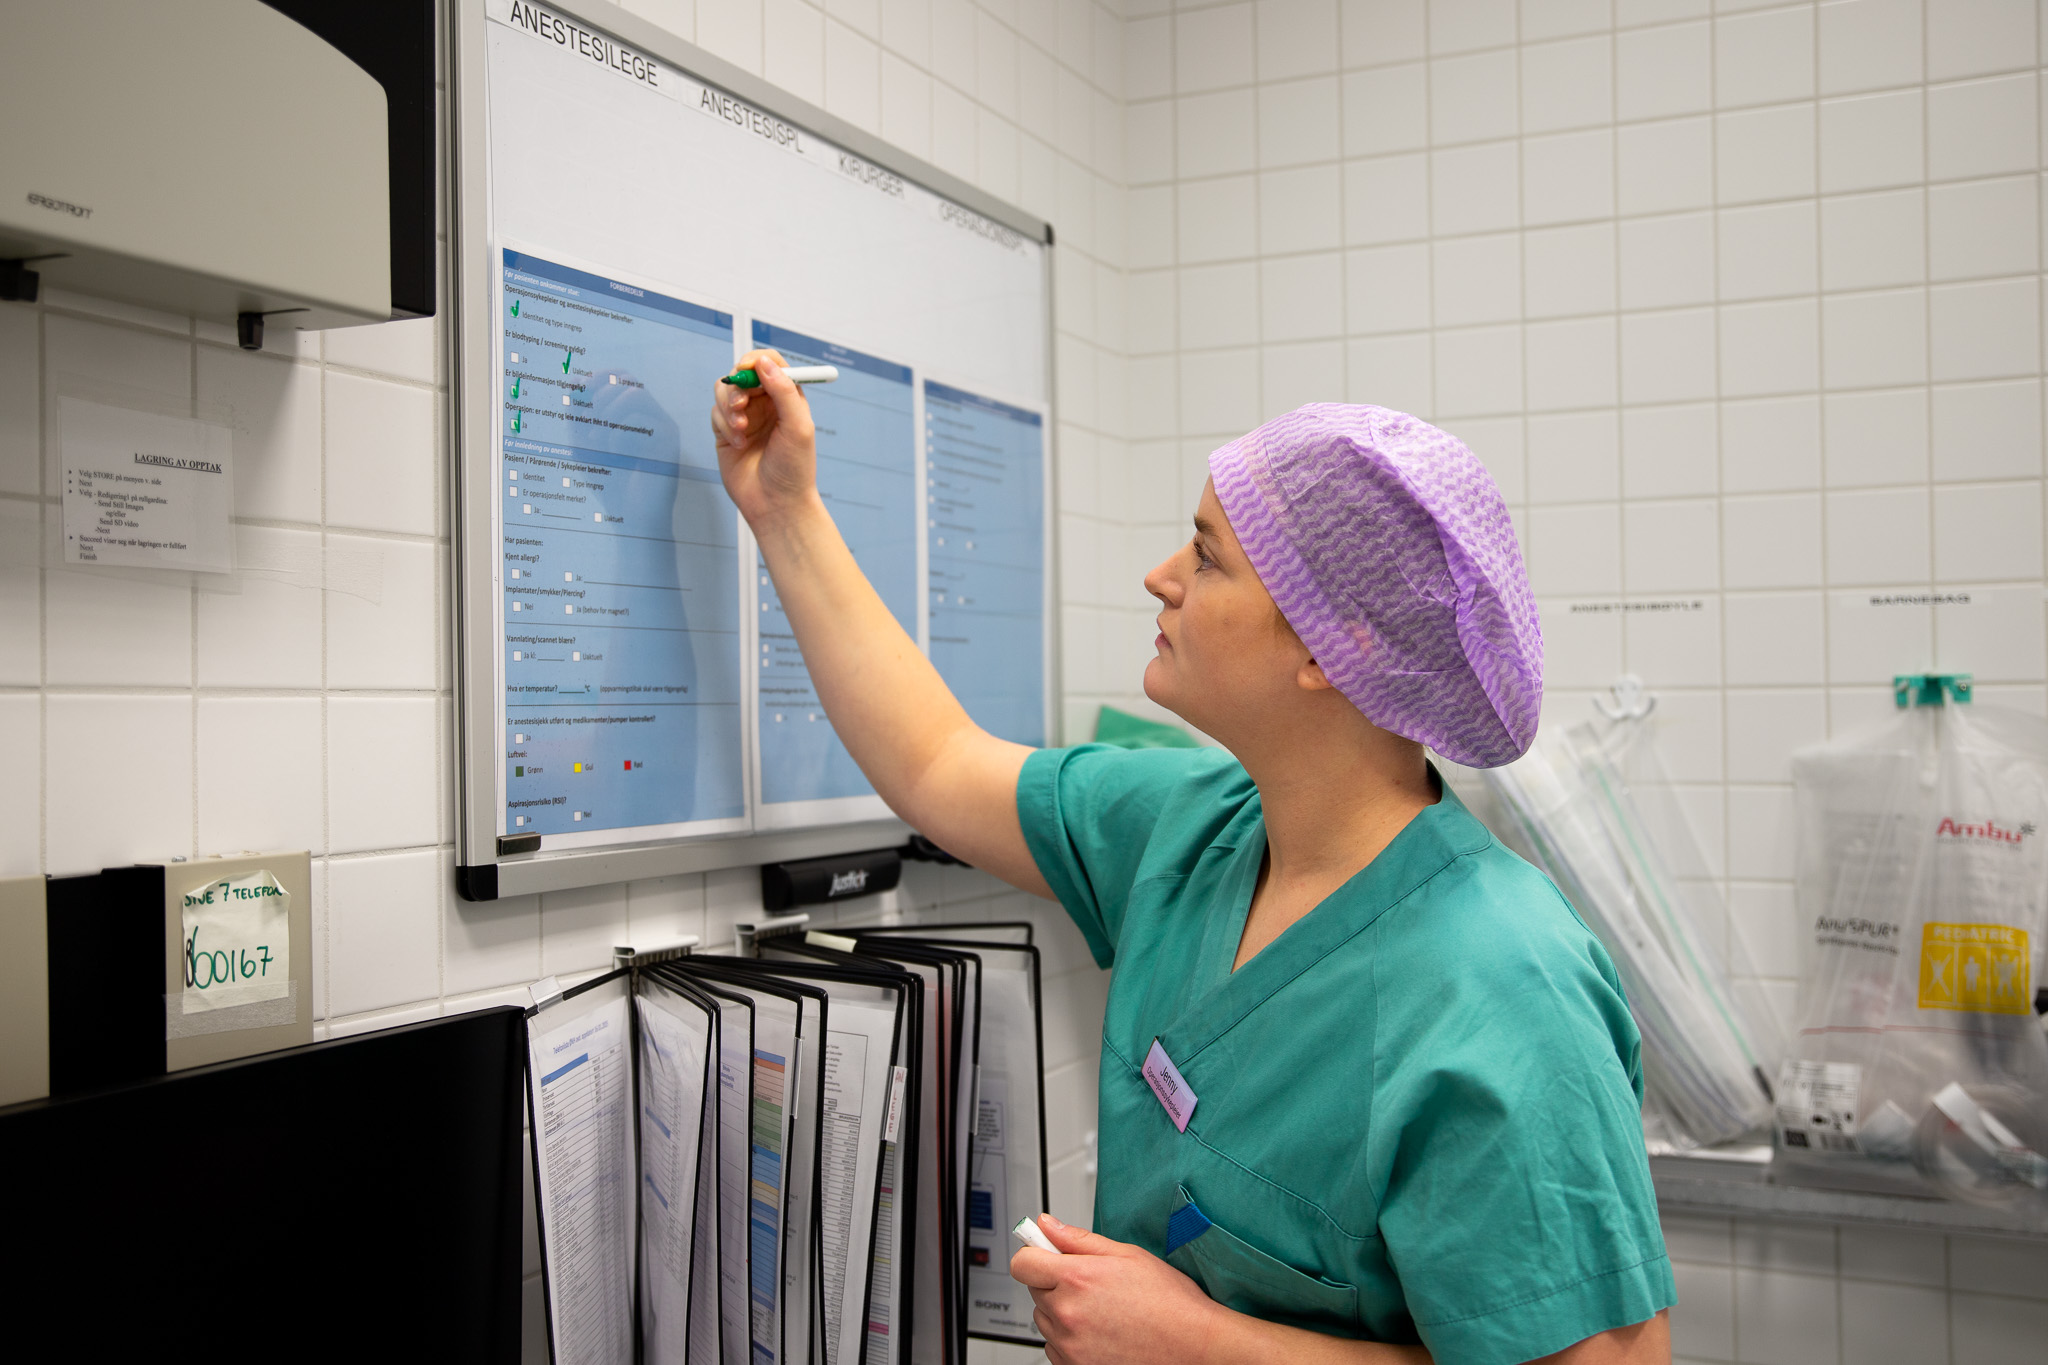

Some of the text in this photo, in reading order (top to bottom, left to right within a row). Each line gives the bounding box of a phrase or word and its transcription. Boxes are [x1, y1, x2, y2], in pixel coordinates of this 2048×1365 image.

[510, 0, 658, 87] ANESTESILEGE
[700, 89, 804, 154] ANESTESISPL
[838, 154, 905, 200] KIRURGER
[610, 282, 644, 298] FORBEREDELSE
[522, 311, 544, 323] Identitet
[552, 320, 563, 328] type
[564, 322, 582, 333] inngrep
[512, 331, 540, 346] blodtyping
[544, 339, 568, 352] screening
[512, 369, 556, 386] bildeinformasjon
[505, 402, 534, 414] Operasjon:
[542, 409, 557, 419] utstyr
[558, 412, 564, 421] og
[573, 398, 594, 409] Uaktuelt
[505, 439, 514, 447] Før
[515, 441, 542, 453] innledning
[135, 453, 222, 472] LAGRING AV OPPTAK
[505, 453, 524, 463] Pasjent
[530, 457, 556, 468] Pårørende
[561, 462, 587, 473] Sykepleier
[79, 470, 92, 479] Velg
[523, 473, 604, 491] Identitet Type inngrep
[79, 489, 92, 498] Velg
[530, 490, 565, 501] operasjonsfelt
[566, 495, 586, 503] merket?
[516, 538, 543, 547] pasienten:
[505, 553, 539, 564] Kjent allergi?
[506, 586, 586, 598] Implantater/smykker/Piercing?
[1870, 594, 1970, 606] BARNEBAG
[507, 635, 557, 644] Vannlating/scannet
[507, 684, 518, 692] Hva
[526, 684, 558, 694] temperatur?
[514, 717, 548, 726] anestesisjekk
[573, 716, 628, 725] medikamenter/pumper
[508, 799, 551, 808] Aspirasjonsrisiko
[1936, 817, 2022, 844] Ambu
[219, 882, 230, 902] 7
[1934, 926, 2014, 944] PEDIATRIC
[186, 926, 273, 989] 860167
[1160, 1066, 1178, 1096] Jenny
[975, 1300, 1010, 1312] SONY
